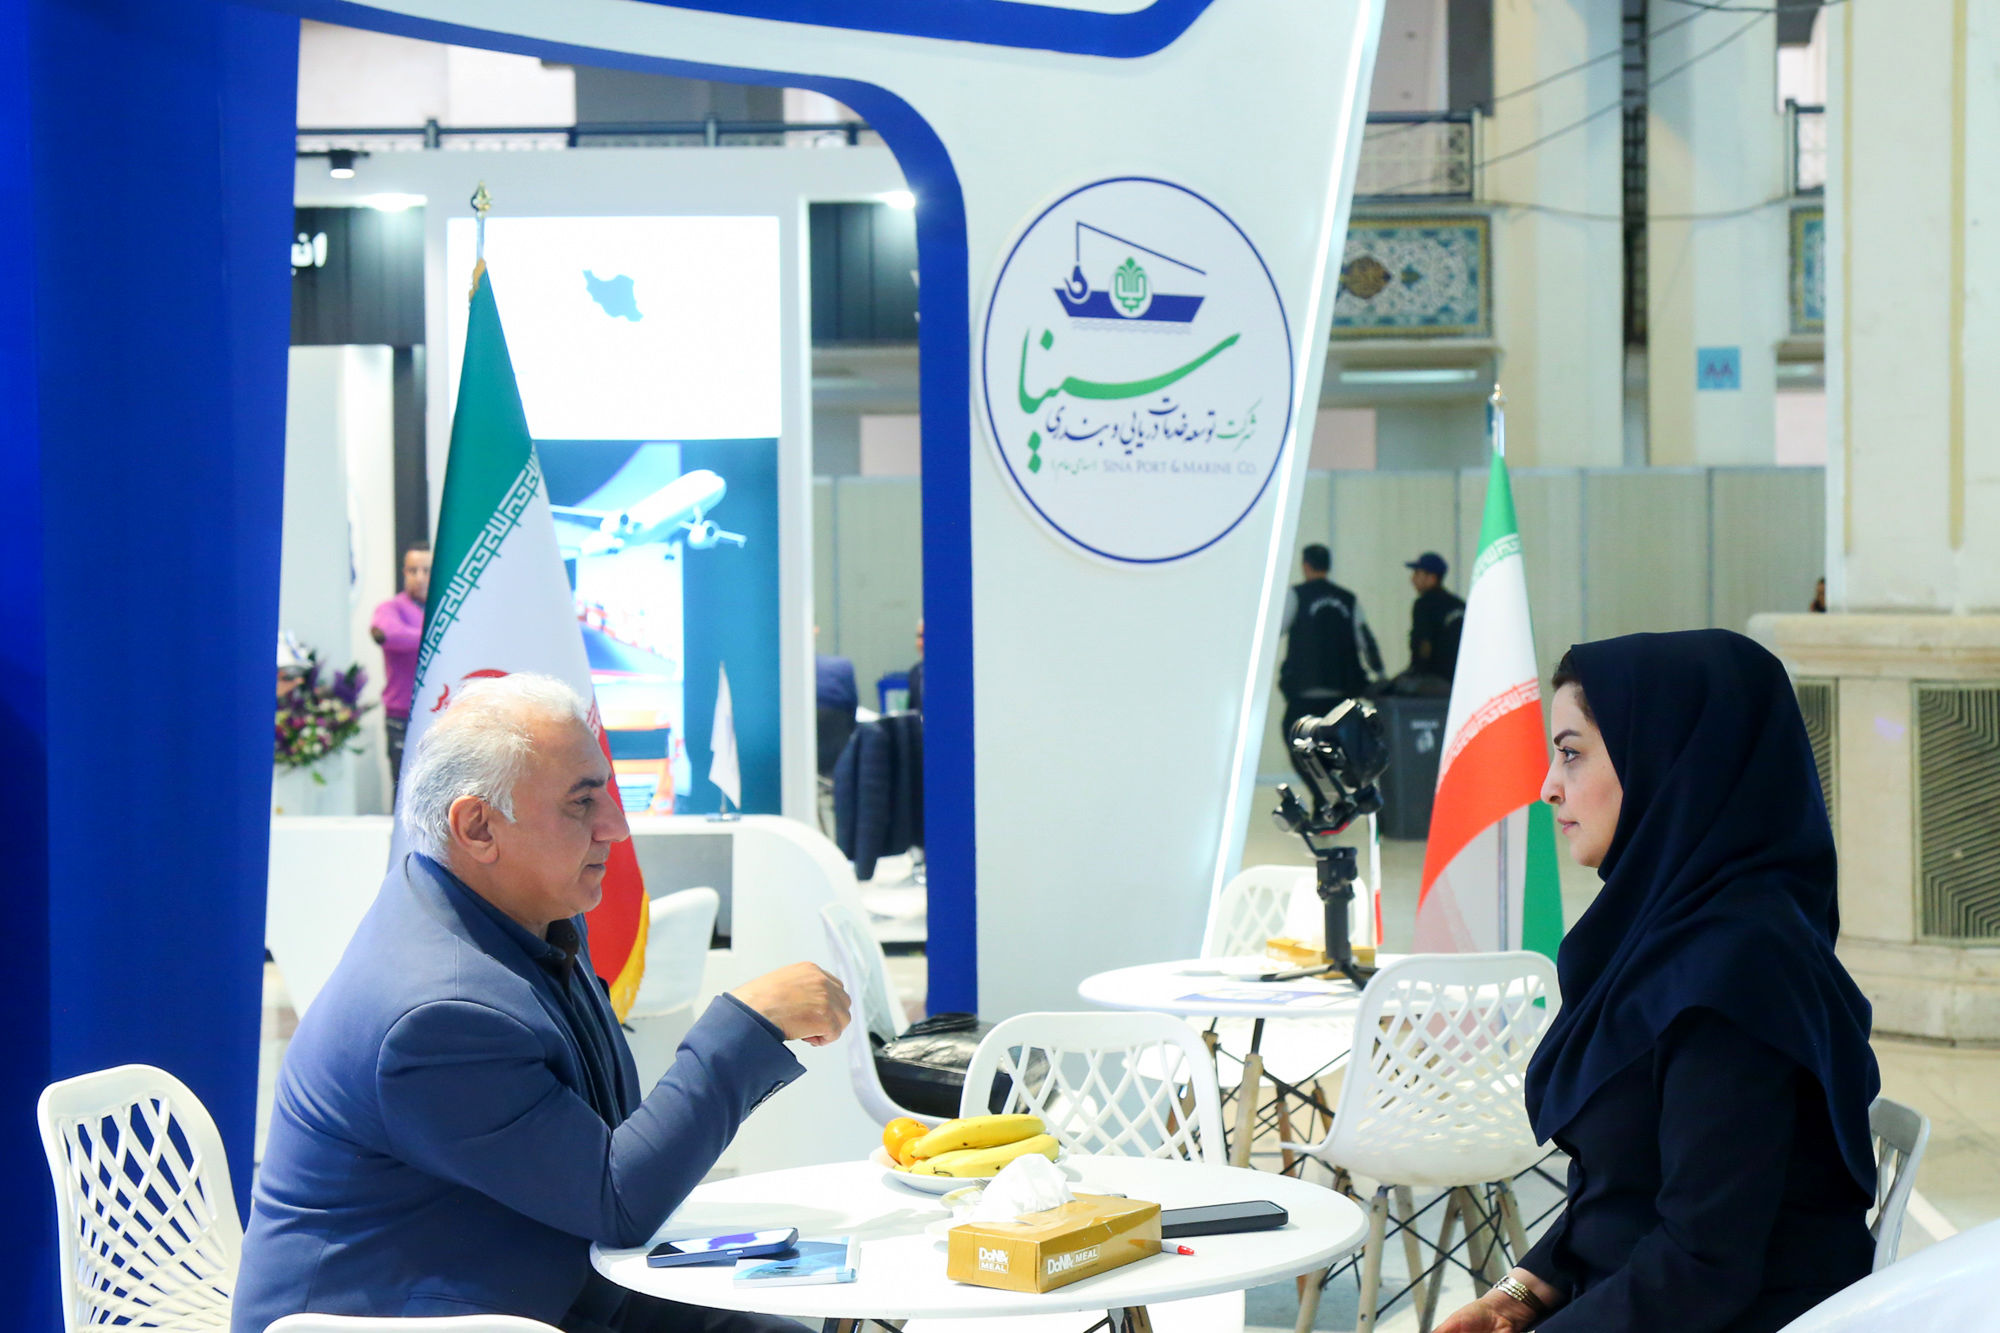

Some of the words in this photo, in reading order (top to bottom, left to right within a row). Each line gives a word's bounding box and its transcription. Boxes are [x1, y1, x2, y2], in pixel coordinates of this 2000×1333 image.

[1019, 328, 1240, 473] سینا
[1148, 397, 1187, 439] خدمات
[1046, 405, 1110, 447] بندری
[1185, 410, 1216, 443] توسعه
[1217, 397, 1262, 451] شرکت
[1075, 1248, 1098, 1263] MEAL
